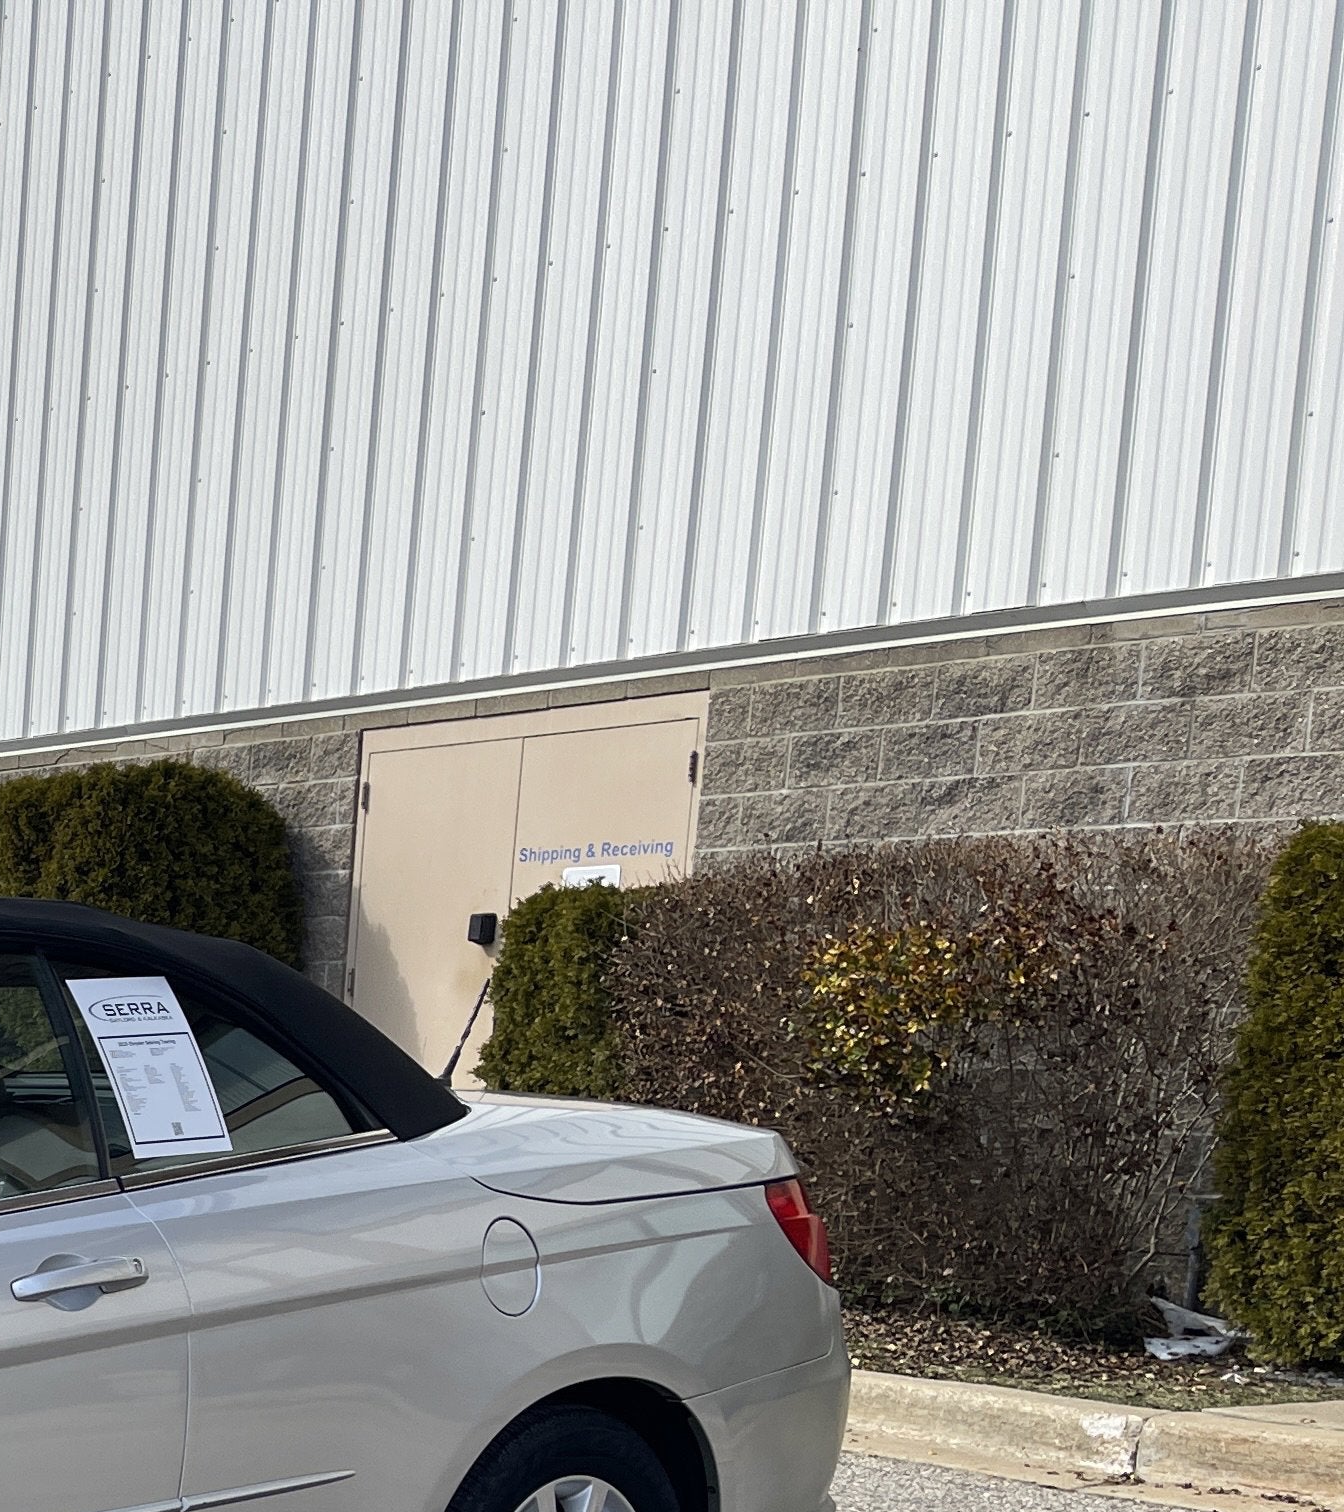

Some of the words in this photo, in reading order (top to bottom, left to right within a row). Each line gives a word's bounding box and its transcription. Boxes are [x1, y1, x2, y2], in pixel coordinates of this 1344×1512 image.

[519, 845, 581, 864] Shipping
[586, 843, 596, 858] &
[601, 840, 674, 858] Receiving
[102, 1001, 170, 1017] SERRA
